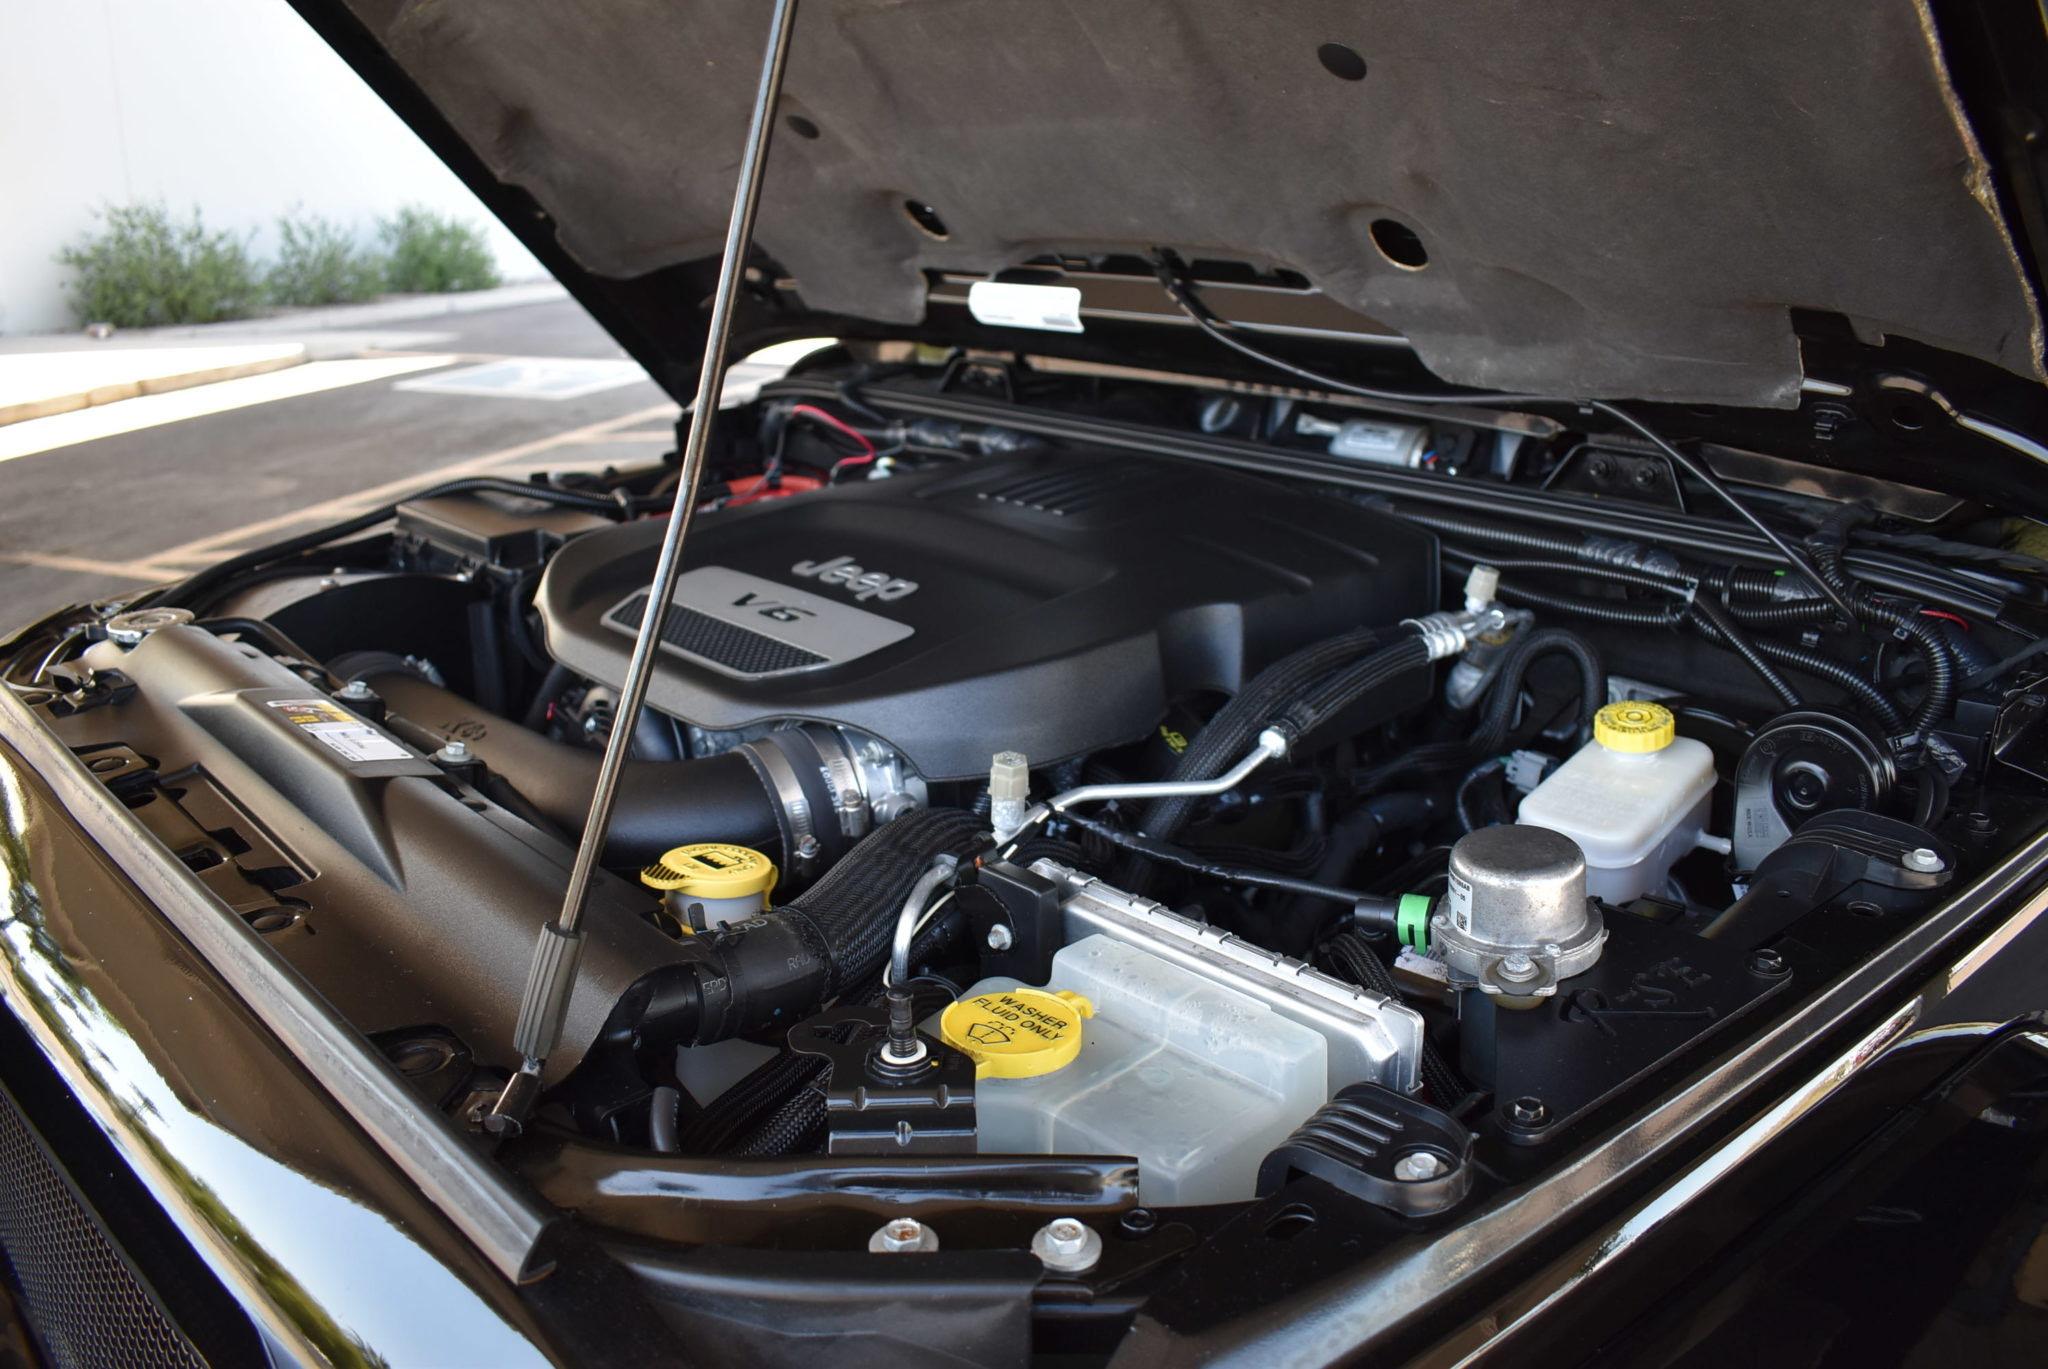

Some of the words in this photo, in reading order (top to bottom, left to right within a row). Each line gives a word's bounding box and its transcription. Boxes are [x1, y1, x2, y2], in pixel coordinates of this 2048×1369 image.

[791, 555, 919, 602] Jeep
[732, 592, 818, 622] V6
[972, 997, 1020, 1021] FLUID
[1020, 1020, 1064, 1041] ONLY
[999, 995, 1068, 1029] WASHER
